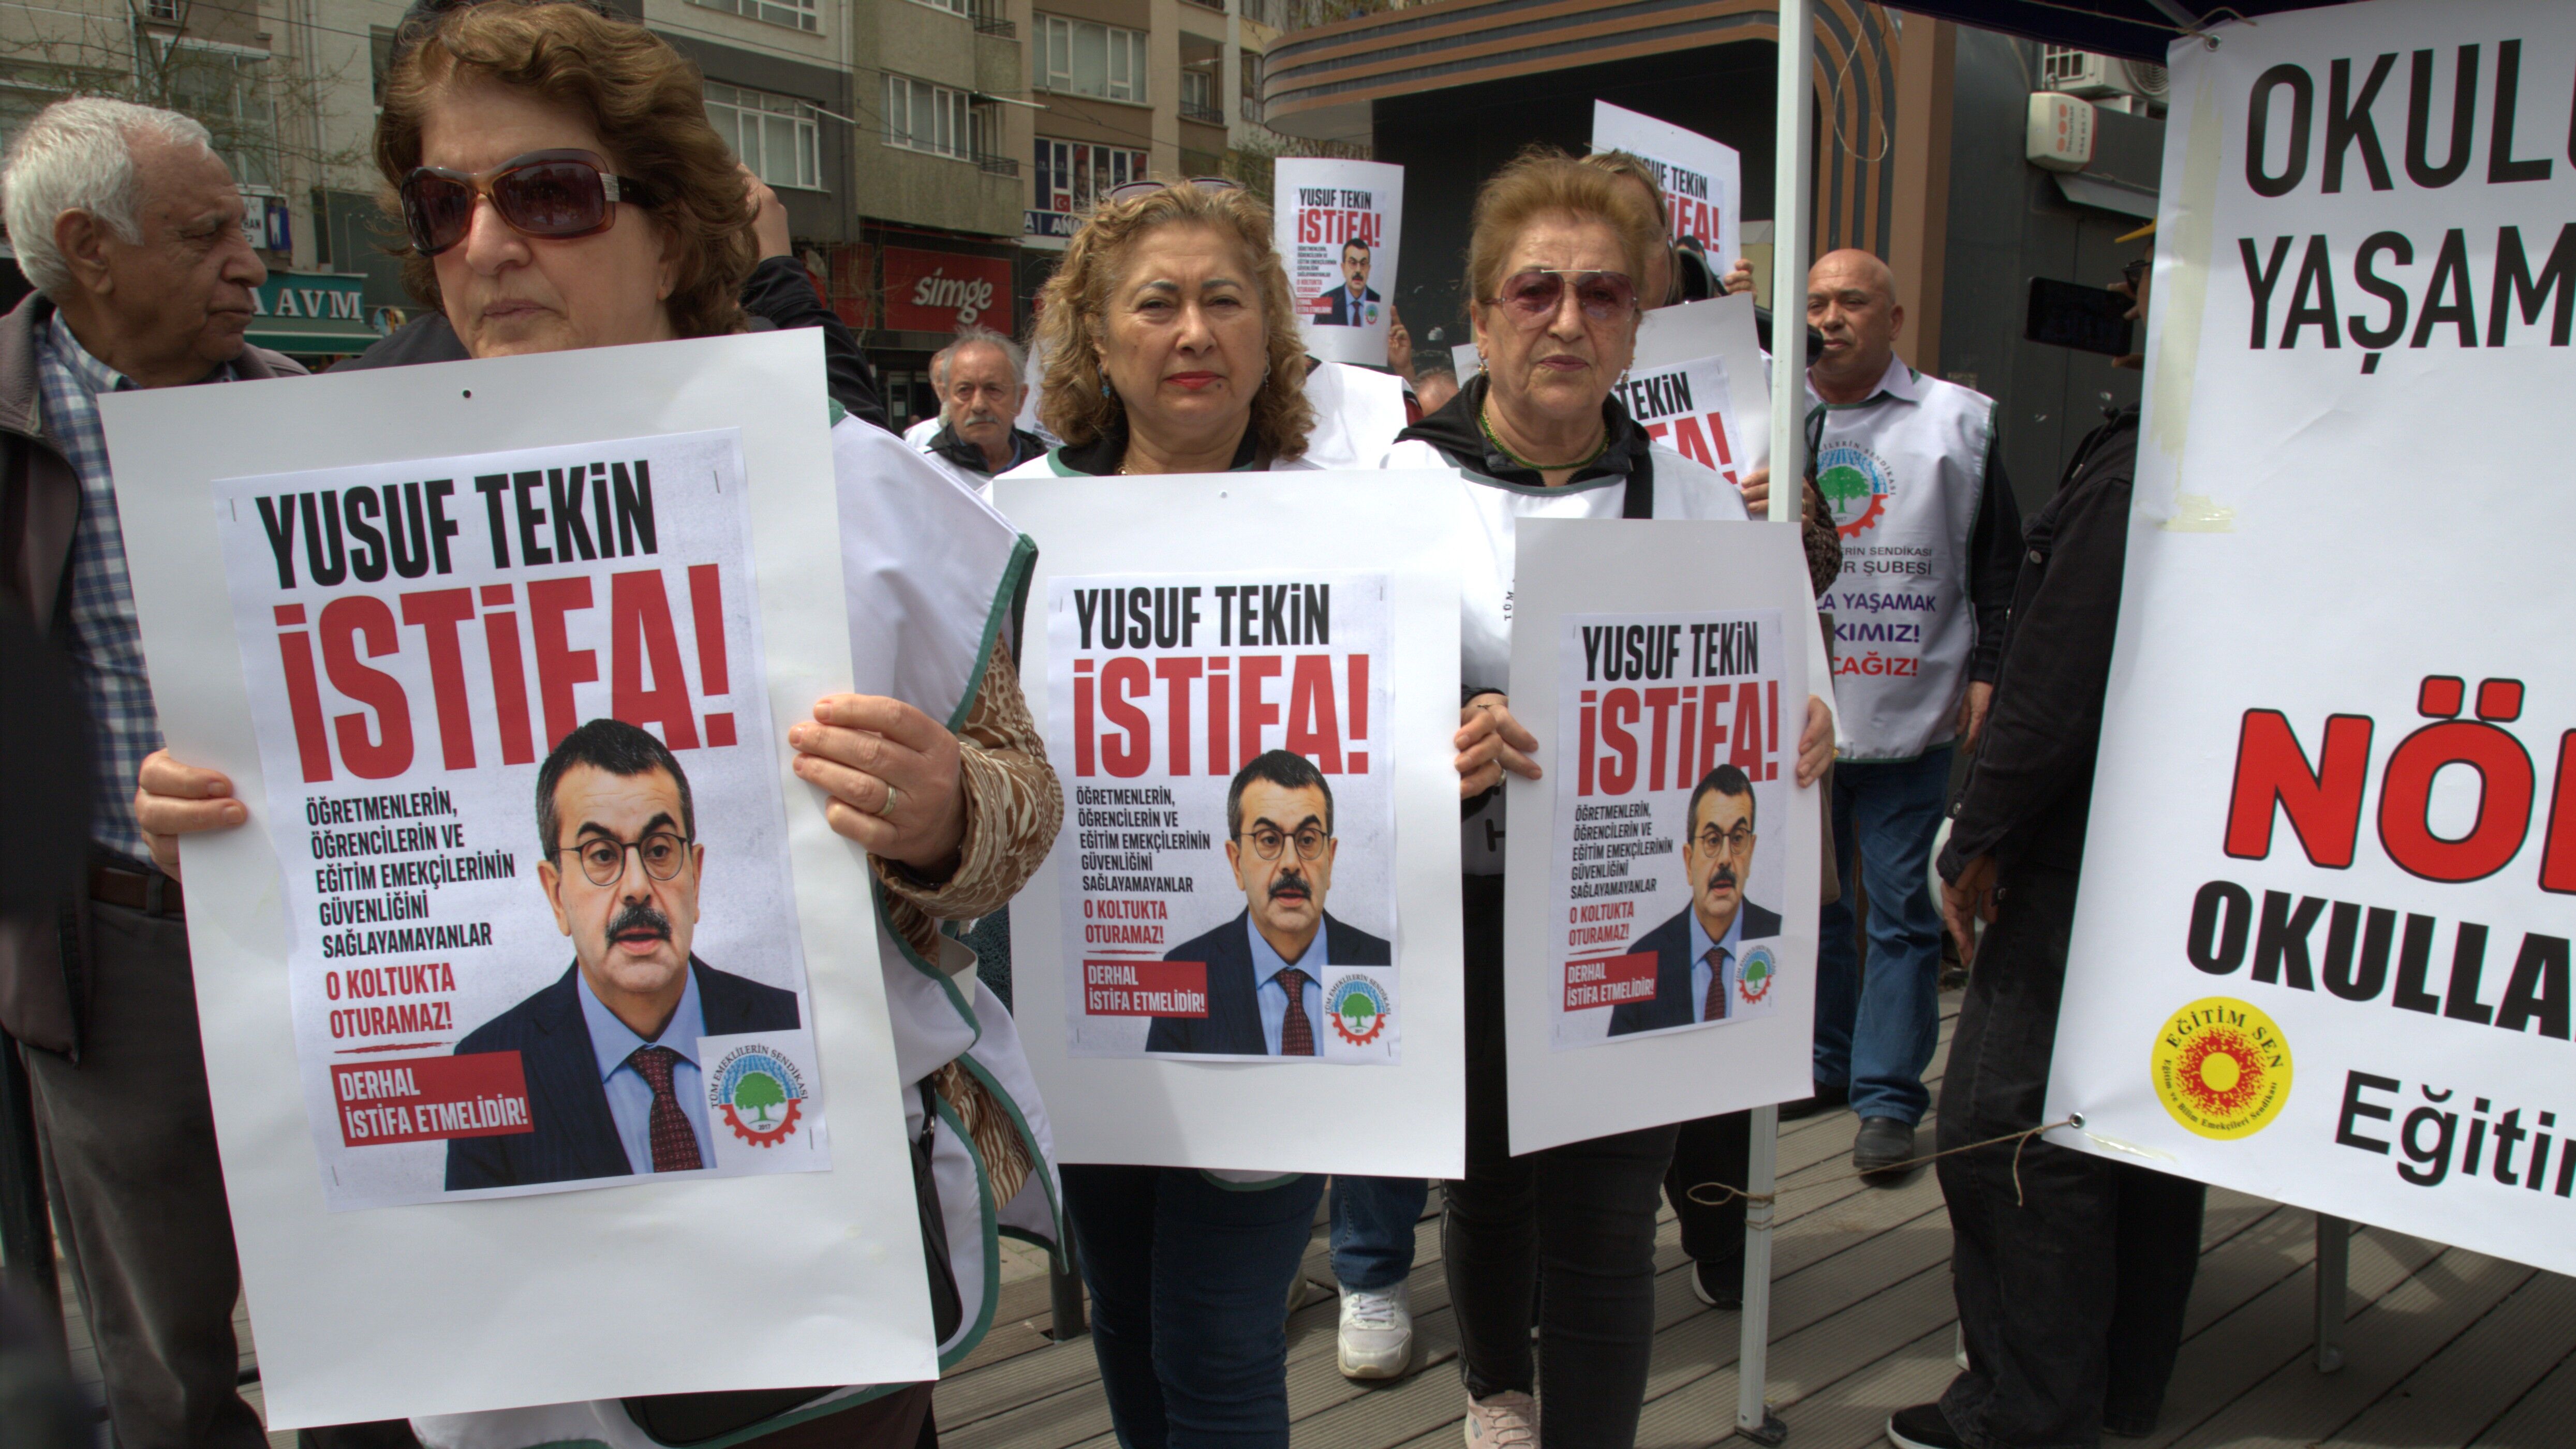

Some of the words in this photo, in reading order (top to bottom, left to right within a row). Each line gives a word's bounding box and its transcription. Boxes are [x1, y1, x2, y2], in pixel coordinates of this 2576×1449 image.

[2245, 38, 2576, 198] OKUL
[1299, 189, 1337, 206] YUSUF
[1340, 190, 1372, 209] TEKİN
[1671, 166, 1707, 200] TEKİN
[1298, 209, 1381, 247] İSTİFA!
[1660, 190, 1719, 253] İFA!
[274, 288, 363, 319] AVM
[911, 267, 993, 324] simge
[2237, 222, 2576, 375] YAŞAM
[1615, 372, 1693, 421] TEKİN
[1864, 448, 1896, 495] SENDİKASI
[254, 479, 459, 589] YUSUF
[474, 460, 658, 569] TEKİN
[1863, 560, 1932, 576] ŞUBESİ
[1869, 547, 1933, 557] SENDİKASI
[1074, 586, 1201, 649] YUSUF
[1215, 583, 1329, 646] TEKİN
[1843, 593, 1936, 613] YAŞAMAK
[1582, 625, 1681, 682] YUSUF
[1691, 621, 1758, 677] TEKİN
[273, 563, 738, 782] İSTİFA!
[1074, 654, 1369, 778] İSTİFA!
[1578, 680, 1778, 796] İSTİFA!
[306, 786, 457, 825] ÖĞRETMENLERİN,
[1077, 786, 1175, 807] ÖĞRETMENLERİN,
[1575, 801, 1651, 822] ÖĞRETMENLERİN,
[1078, 808, 1160, 827] ÖĞRENCİLERİN
[1164, 811, 1178, 827] VE
[1574, 821, 1639, 841] ÖĞRENCİLERİN
[1641, 822, 1652, 836] VE
[311, 822, 438, 860] ÖĞRENCİLERİN
[441, 823, 465, 848] VE
[1080, 830, 1119, 849] EĞİTİM
[1123, 830, 1210, 853] EMEKÇİLERİNİN
[1573, 842, 1604, 861] EĞİTİM
[1607, 837, 1673, 860] EMEKÇİLERİNİN
[316, 861, 377, 893] EĞİTİM
[382, 849, 515, 889] EMEKÇİLERİNİN
[1082, 852, 1152, 870] GÜVENLİĞİNİ
[1572, 860, 1628, 880] GÜVENLİĞİNİ
[1083, 873, 1193, 892] SAĞLAYAMAYANLAR
[1571, 879, 1657, 899] SAĞLAYAMAYANLAR
[319, 890, 430, 926] GÜVENLİĞİNİ
[1084, 899, 1093, 919] O
[1098, 899, 1168, 920] KOLTUKTA
[1570, 907, 1577, 924] O
[1581, 901, 1634, 923] KOLTUKTA
[323, 922, 493, 958] SAĞLAYAMAYANLAR
[1085, 925, 1164, 944] OTURAMAZ!
[1569, 924, 1629, 946] OTURAMAZ!
[1088, 965, 1138, 985] DERHAL
[1568, 963, 1606, 983] DERHAL
[2186, 880, 2576, 1042] OKULLA
[326, 971, 341, 1000] O
[346, 962, 456, 999] KOLTUKTA
[1567, 983, 1598, 1006] İSTİFA
[1601, 977, 1654, 1002] ETMELİDİR!
[1089, 988, 1130, 1010] İSTİFA
[1133, 989, 1205, 1012] ETMELİDİR!
[330, 1001, 453, 1038] OTURAMAZ!
[2166, 1006, 2246, 1048] EĞİTİM
[2252, 1026, 2284, 1068] SEN
[713, 1043, 769, 1081] EMEKLİLERİN
[771, 1049, 808, 1099] SENDİKASI
[339, 1068, 421, 1101] DERHAL
[709, 1083, 719, 1108] TÜM
[345, 1103, 413, 1138] İSTİFA
[414, 1093, 528, 1132] ETMELİDİR!
[2178, 1102, 2198, 1123] Bilim
[2201, 1117, 2249, 1131] Emekçileri
[2334, 1069, 2576, 1199] Eğiti
